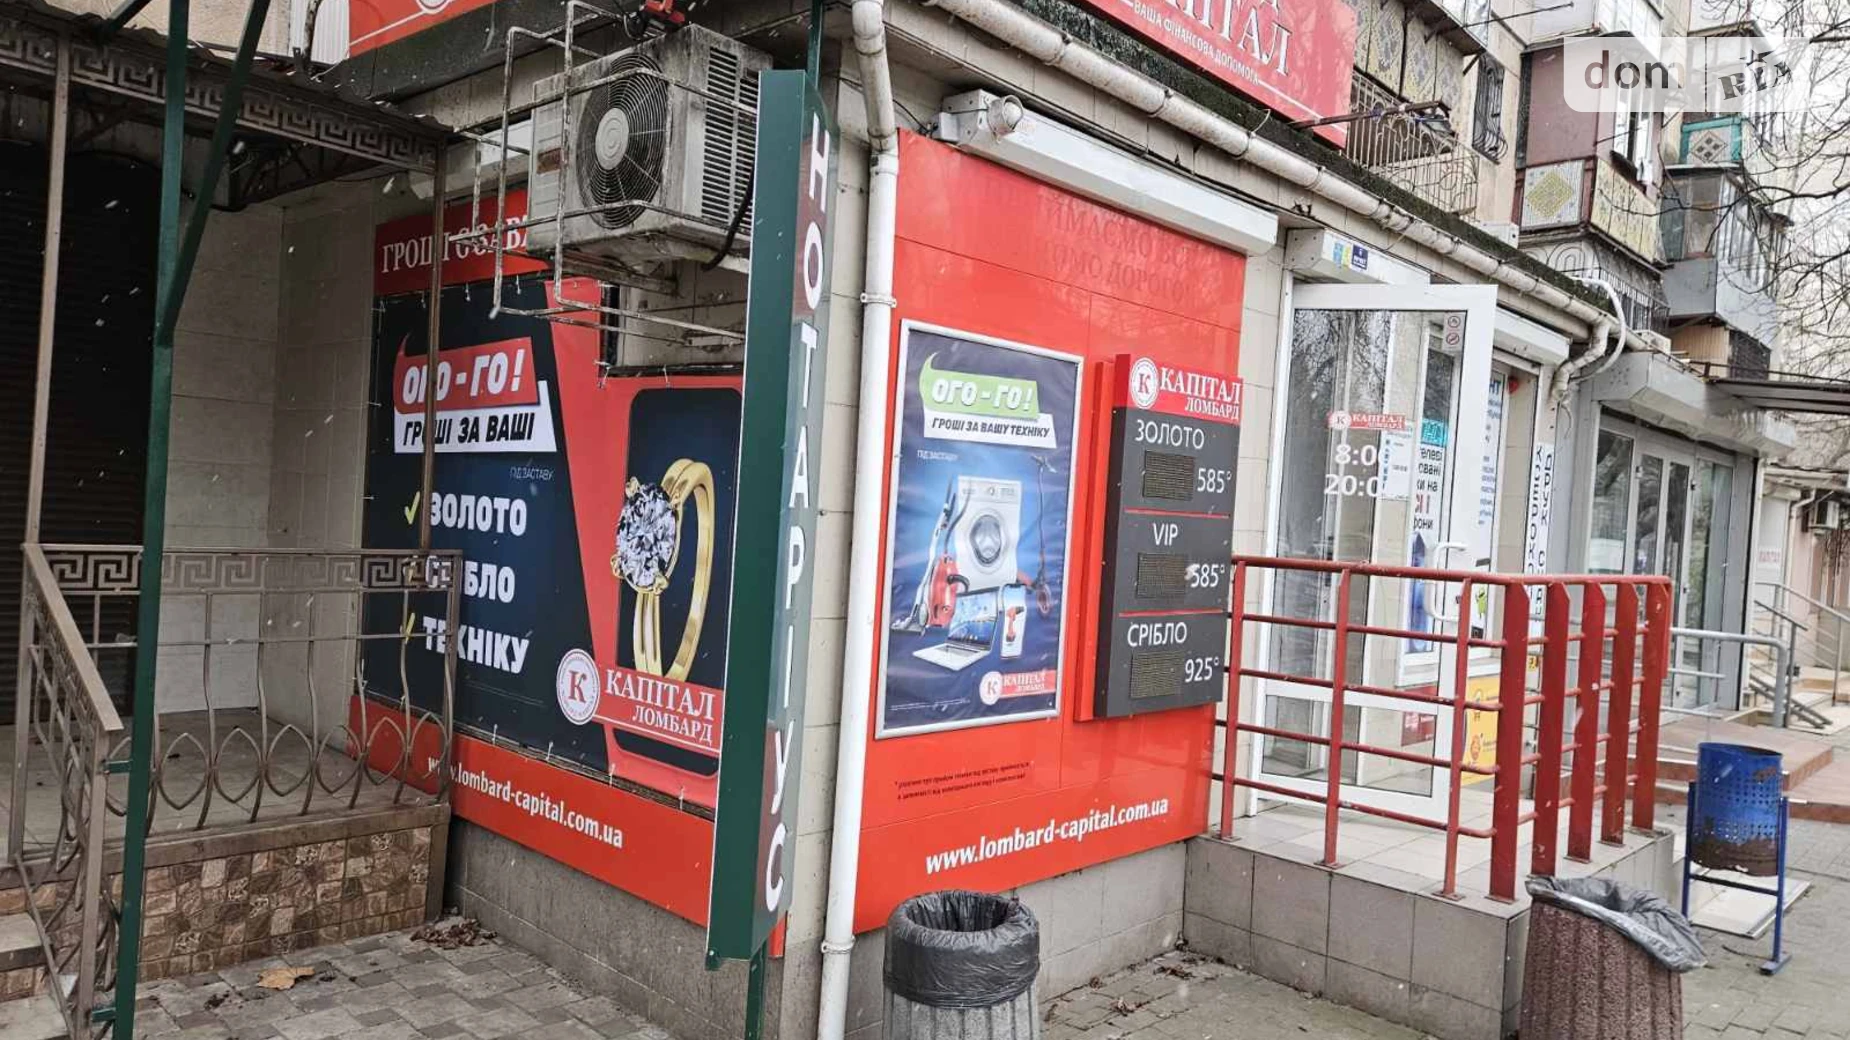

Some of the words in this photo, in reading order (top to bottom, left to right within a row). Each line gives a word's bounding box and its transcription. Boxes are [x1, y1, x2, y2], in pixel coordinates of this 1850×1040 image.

[1133, 2, 1163, 28] ВАША
[1163, 19, 1214, 59] ФІНАНСОВА
[1213, 49, 1260, 86] ДОПОМОГА
[932, 378, 1033, 412] ОГО-ГО!
[1159, 367, 1242, 405] КАПІТАЛ
[931, 417, 965, 432] ГРОШІ
[965, 420, 979, 432] ЗА
[980, 422, 1011, 435] ВАШУ
[1011, 425, 1050, 438] ТЕХНІКУ
[1184, 396, 1240, 421] ЛОМБАРД
[403, 418, 453, 446] ГРШІ
[457, 416, 480, 444] ЗА
[485, 412, 536, 442] ВАШІ
[1134, 419, 1205, 449] ЗОЛОТО
[430, 492, 527, 536] ЗОЛОТО
[766, 112, 831, 912] НОТАРІУС
[1152, 522, 1179, 546] VIP
[423, 615, 530, 674] ТЕХНІКУ
[1126, 621, 1188, 648] СРІБЛО
[606, 669, 716, 721] КАПІТАЛ
[632, 704, 713, 745] ЛОМБАРД
[925, 798, 1169, 875] www.lombard-capital.com.ua
